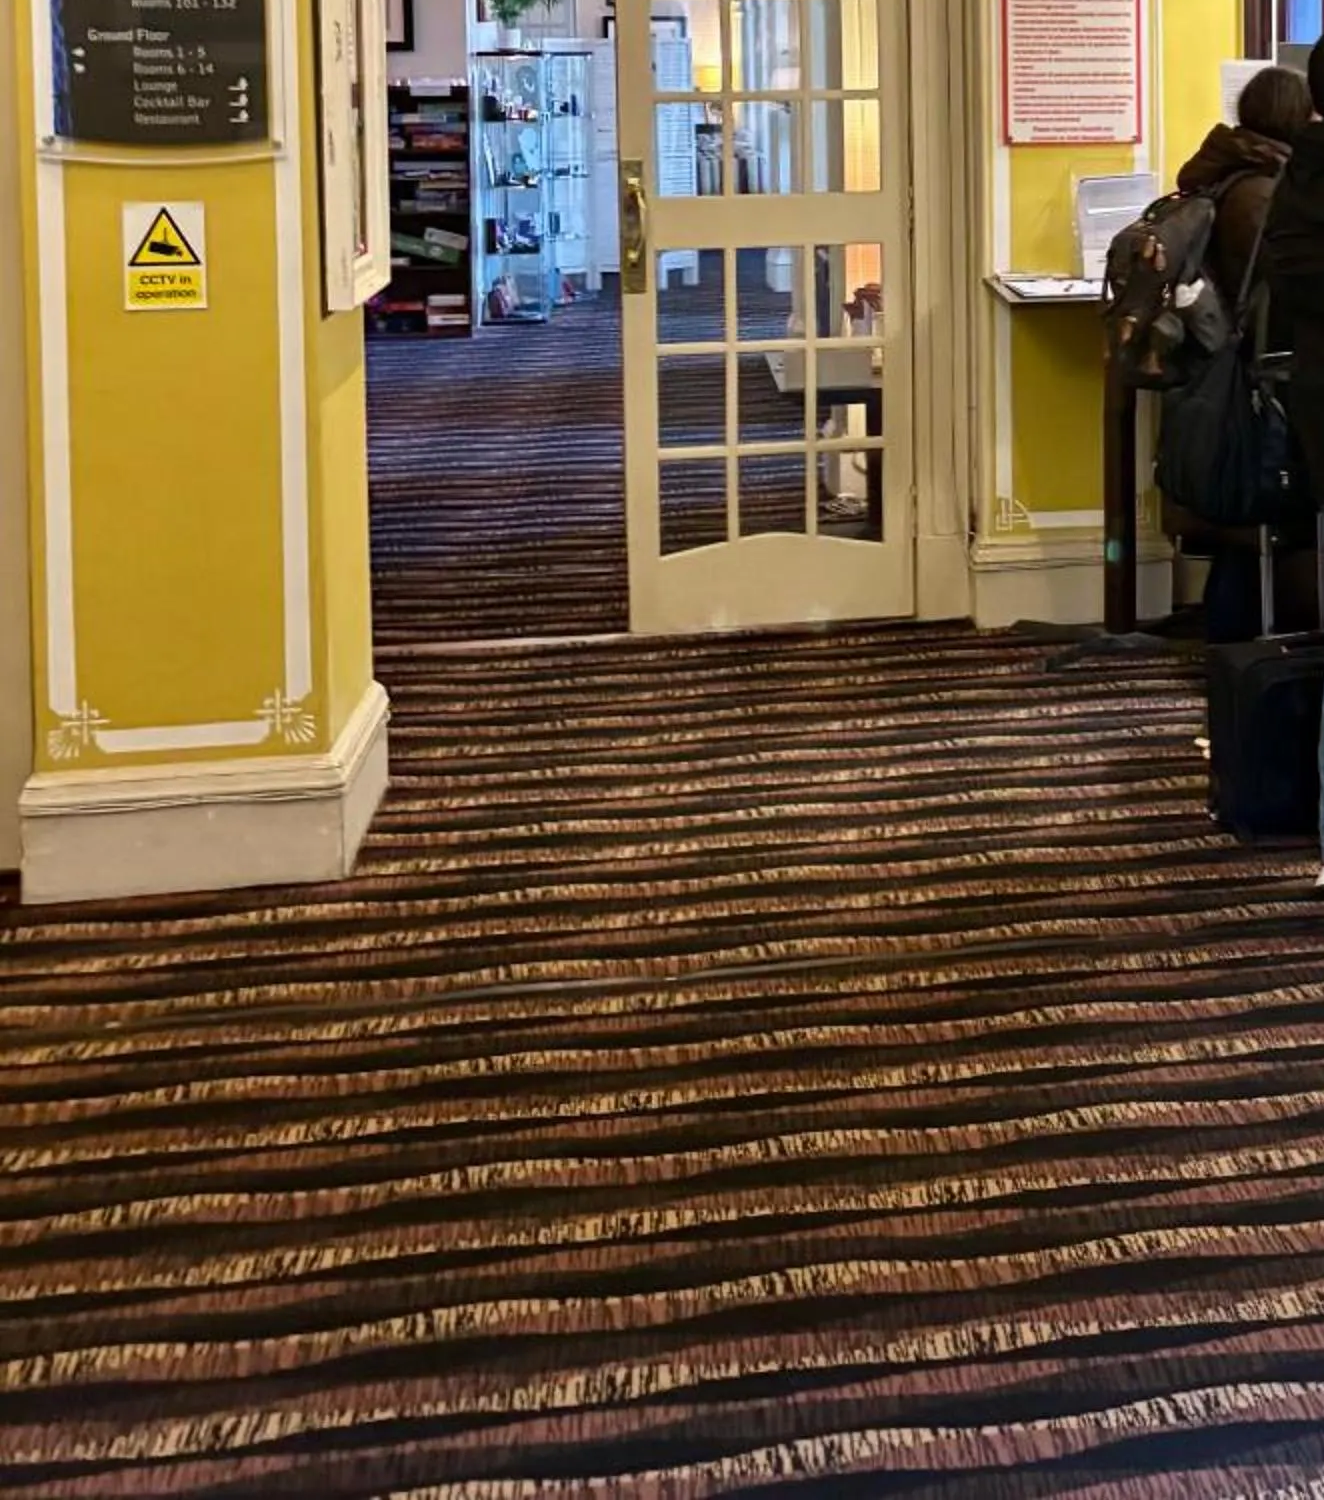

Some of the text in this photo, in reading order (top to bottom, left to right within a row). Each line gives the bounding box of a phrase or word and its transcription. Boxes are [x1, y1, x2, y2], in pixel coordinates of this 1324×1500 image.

[87, 29, 170, 42] Ground Floor
[133, 46, 174, 58] Rooms
[133, 62, 174, 75] Rooms
[133, 80, 178, 94] Lounge
[133, 95, 211, 109] Cocktail Bar
[140, 275, 192, 285] CCTV in
[135, 289, 197, 300] operation
